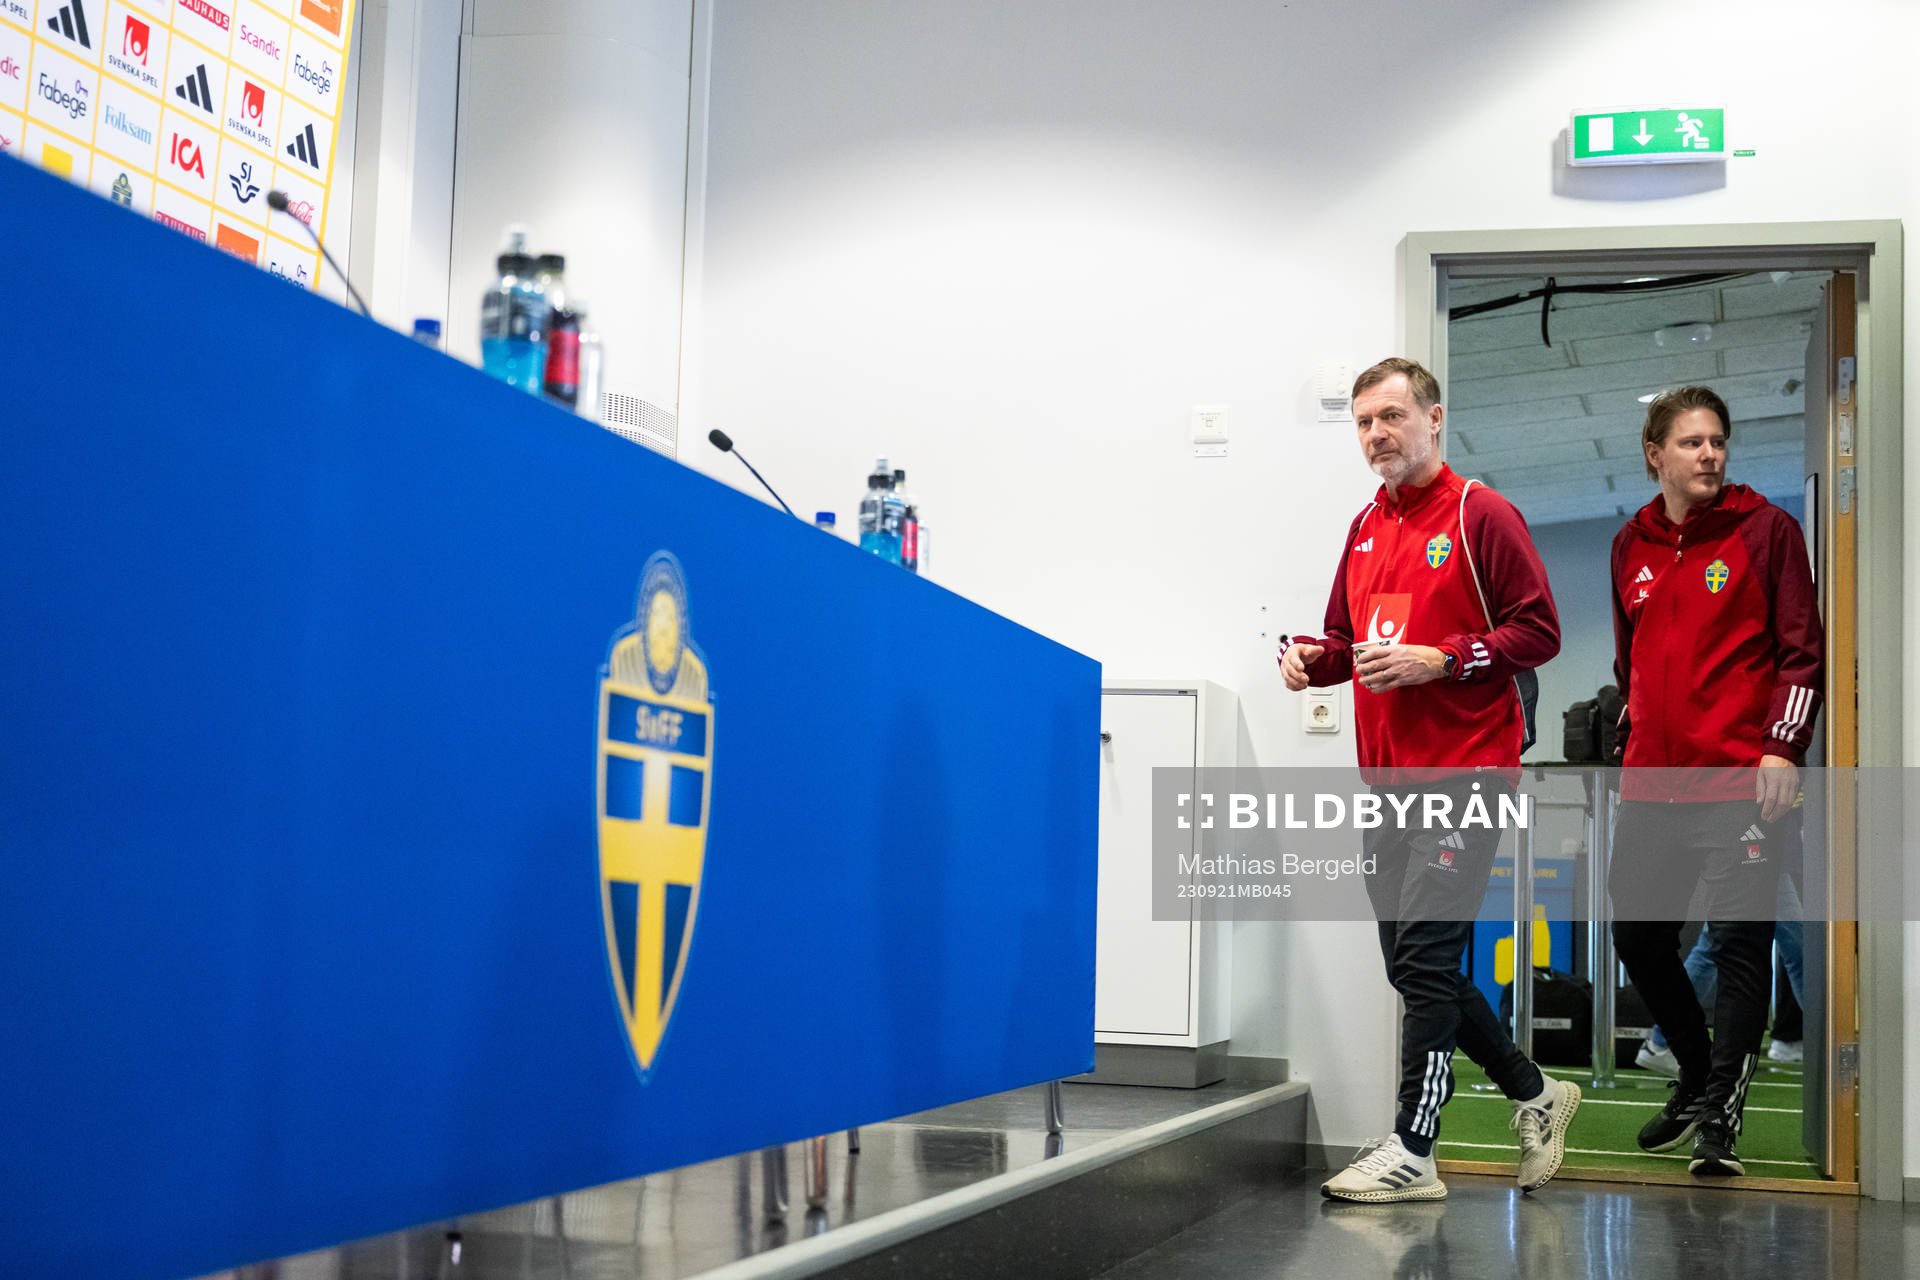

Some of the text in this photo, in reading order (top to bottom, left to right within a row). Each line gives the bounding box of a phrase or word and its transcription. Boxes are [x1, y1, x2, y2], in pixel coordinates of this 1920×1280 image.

[10, 2, 28, 20] SPEL
[180, 0, 229, 28] AUHAUS
[240, 25, 281, 61] Scandic
[108, 54, 158, 88] SVENSKA SPEL
[294, 54, 331, 95] Fabege
[38, 72, 87, 119] Fabege
[104, 104, 151, 145] Folksam
[228, 117, 272, 148] SVENSKA SPEL
[170, 132, 205, 180] ICA
[240, 161, 252, 183] SJ
